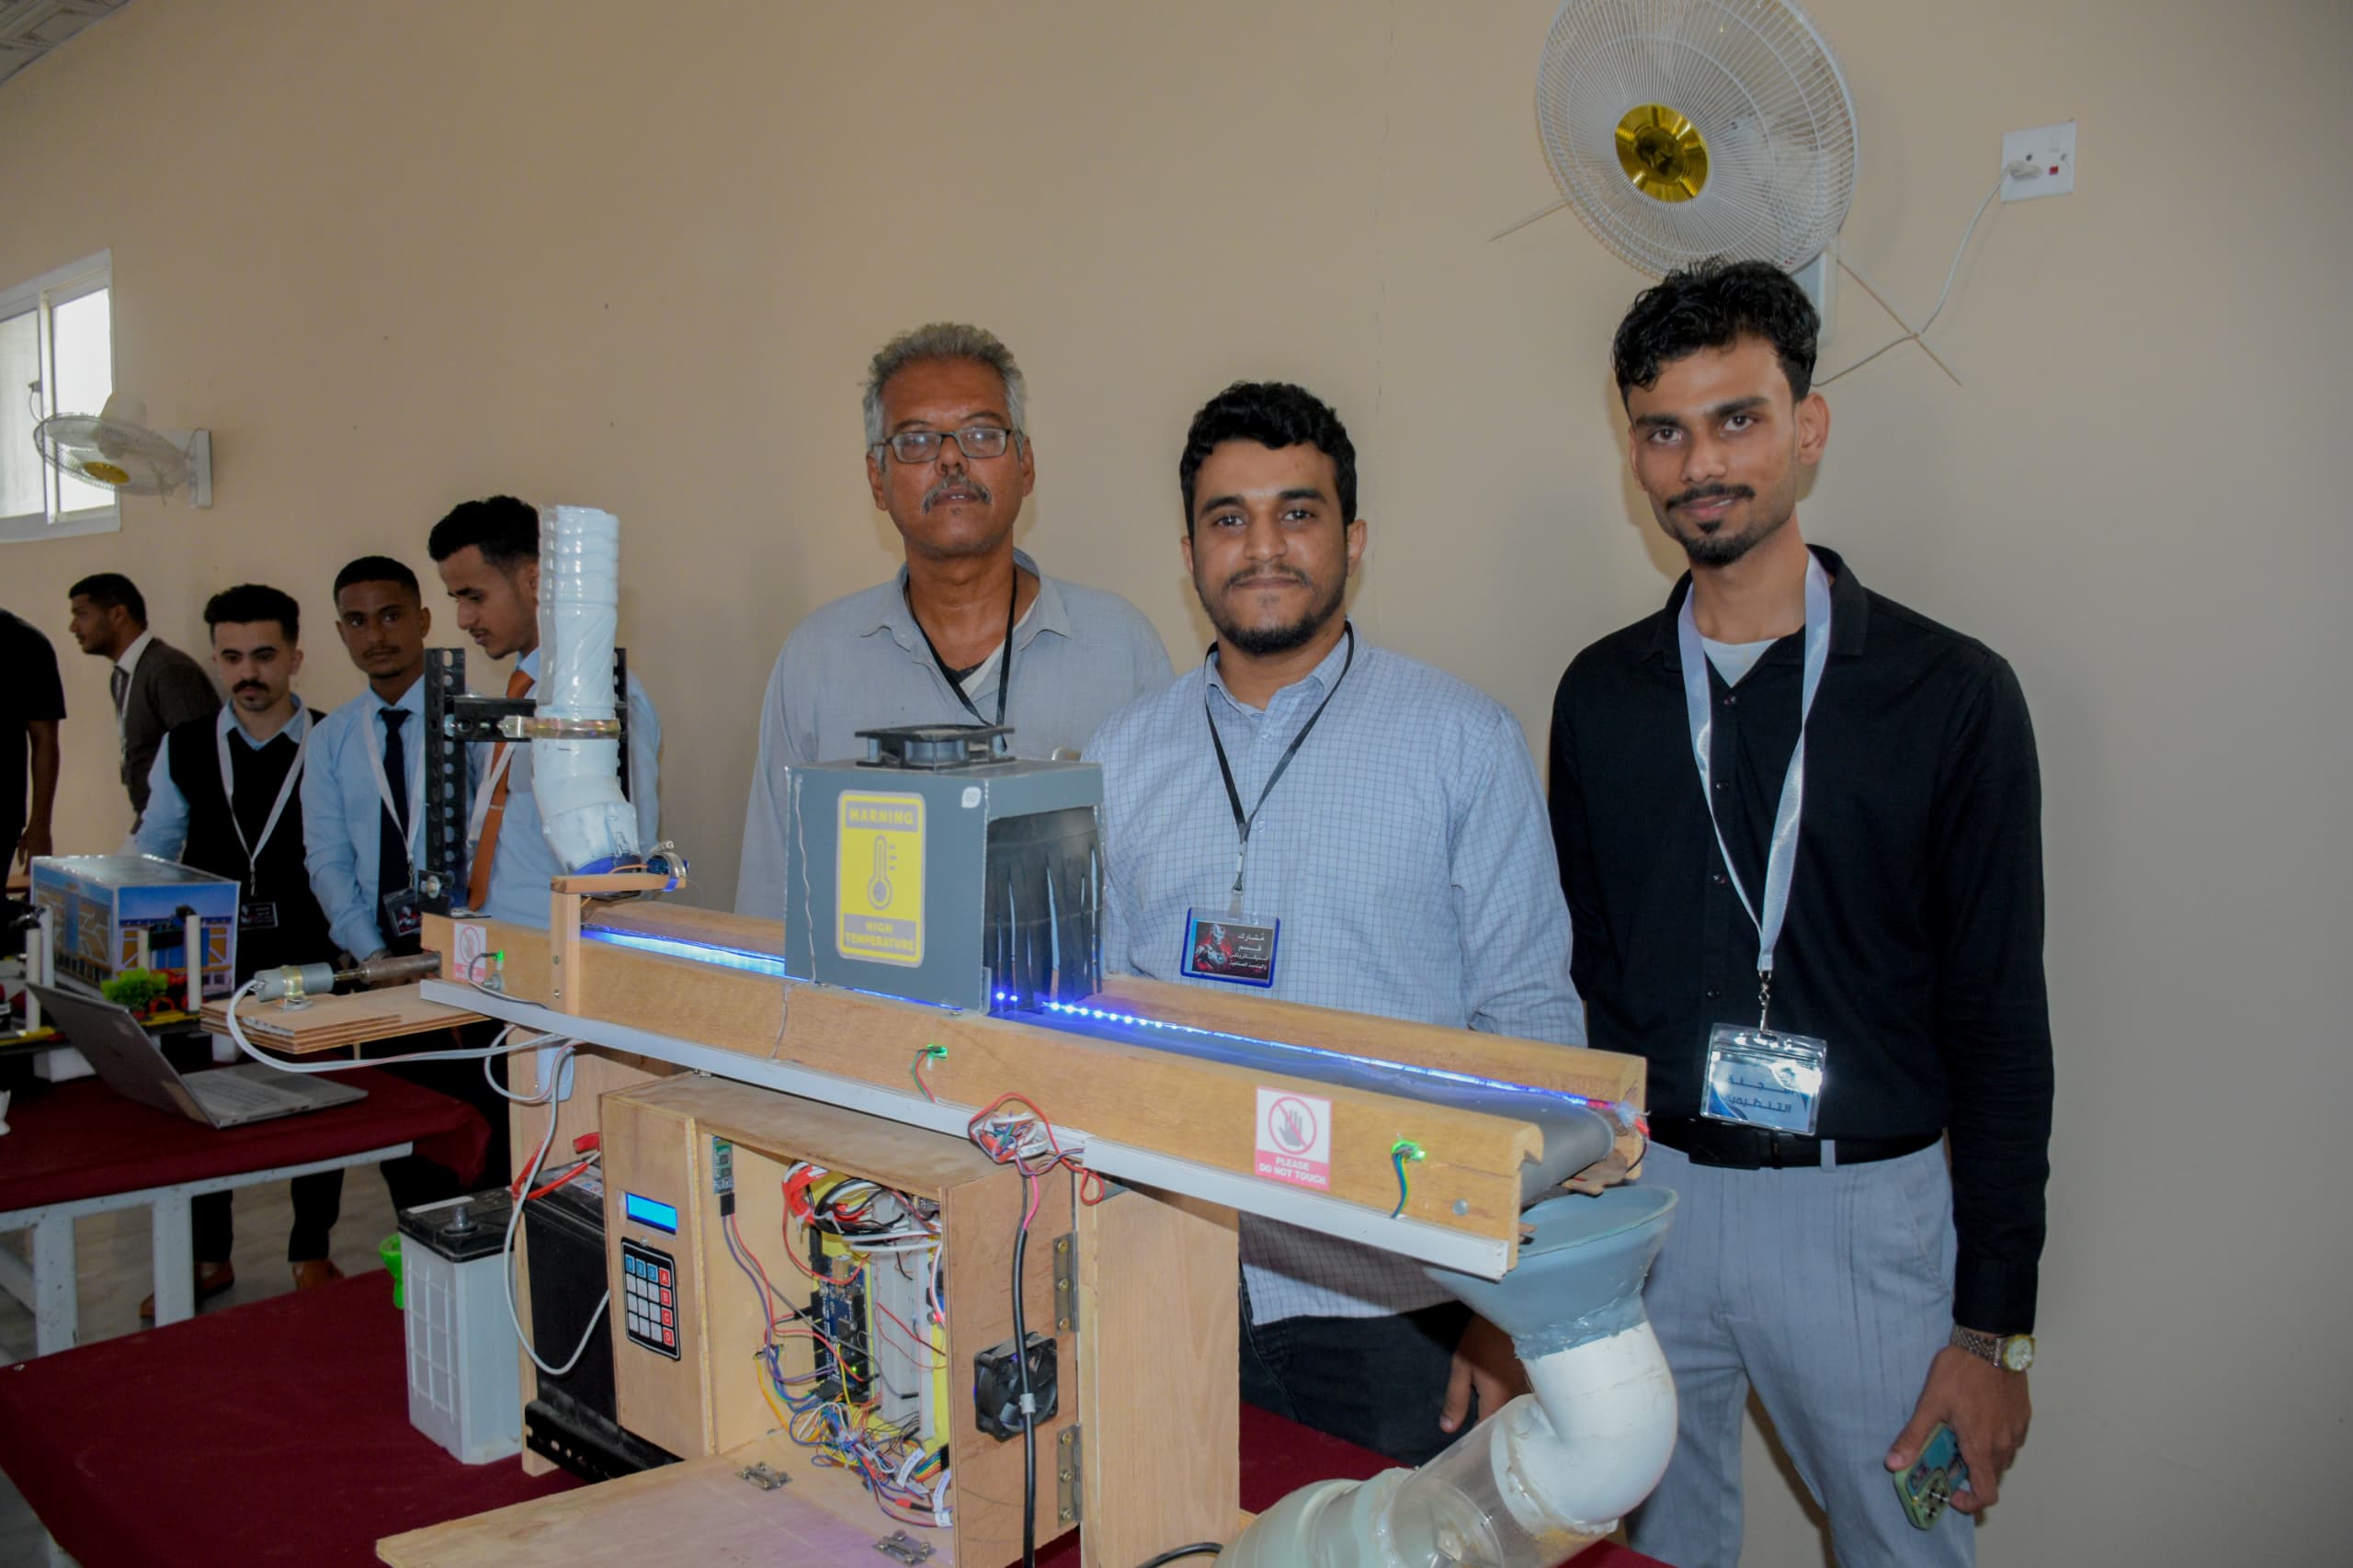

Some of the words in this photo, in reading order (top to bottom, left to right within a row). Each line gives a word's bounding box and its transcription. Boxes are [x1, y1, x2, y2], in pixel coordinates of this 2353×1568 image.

[850, 808, 914, 824] WARNING
[866, 921, 893, 934] HIGH
[846, 932, 915, 950] TEMPERATURE
[1276, 1156, 1310, 1171] PLEASE
[1258, 1163, 1272, 1174] DO
[1274, 1165, 1293, 1177] NOT
[1294, 1170, 1326, 1185] TOUCH
